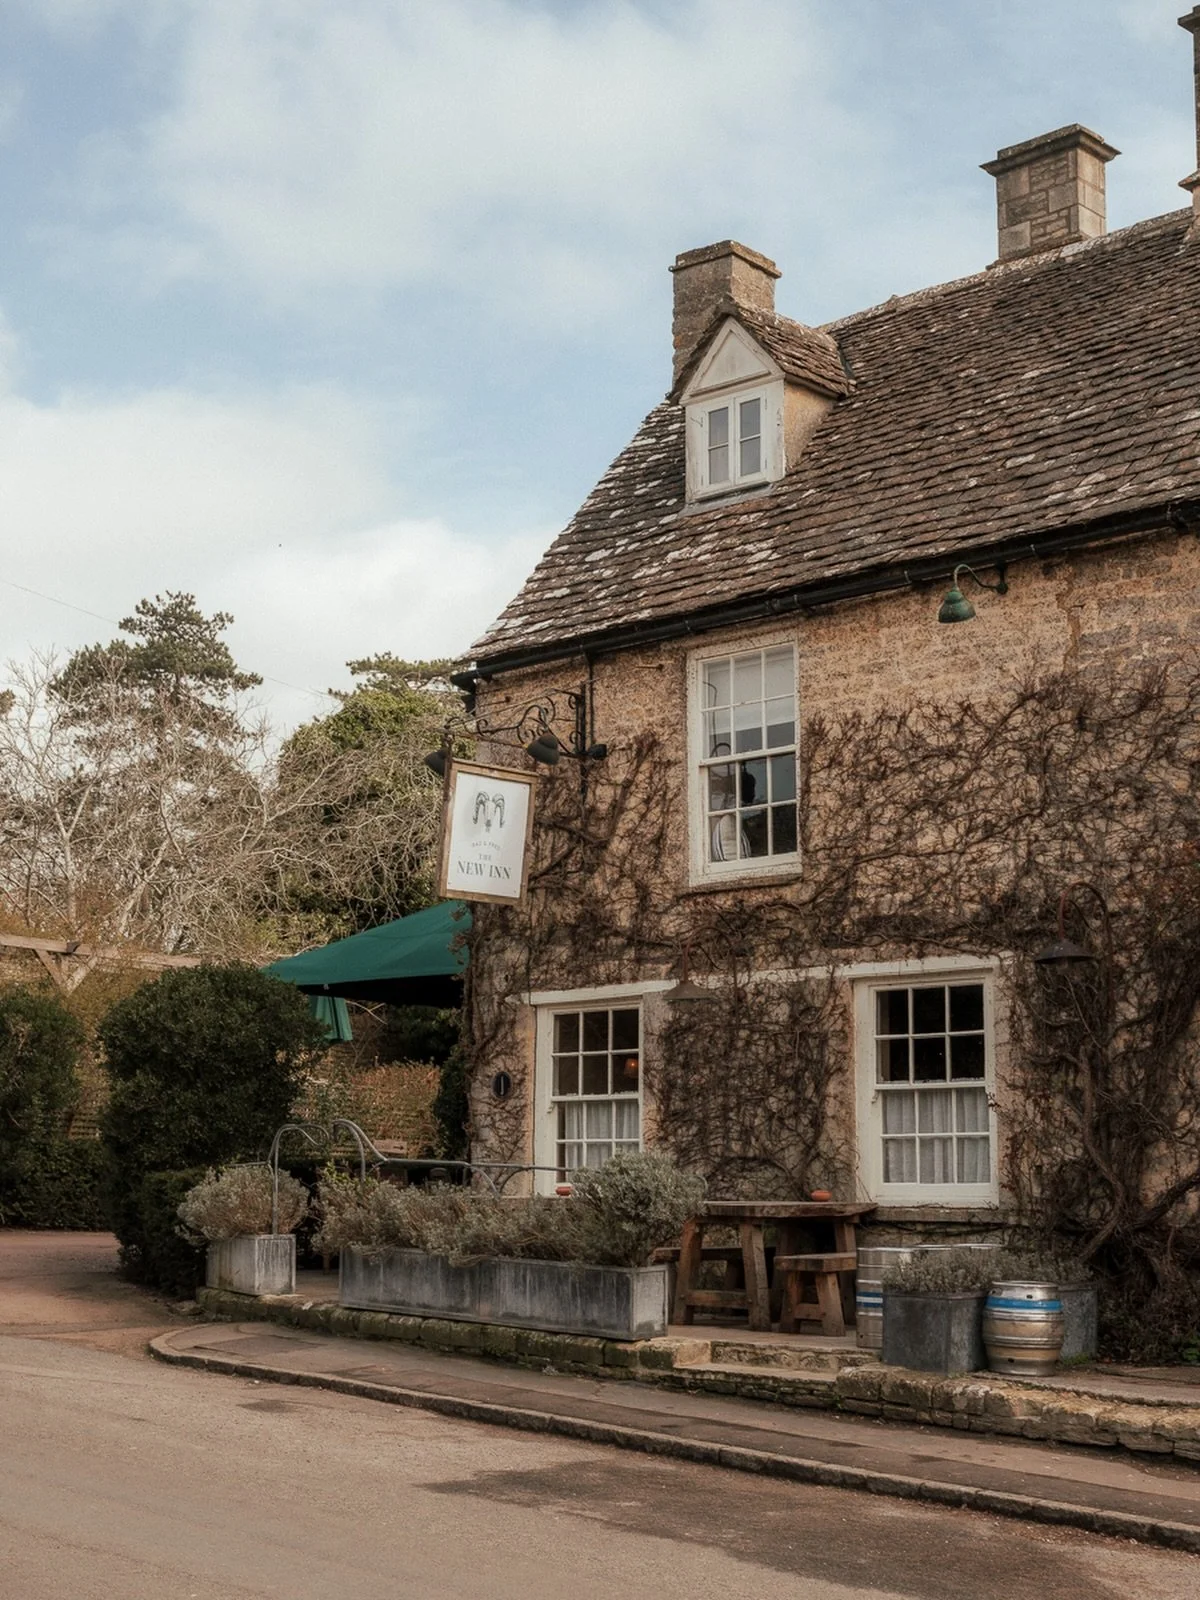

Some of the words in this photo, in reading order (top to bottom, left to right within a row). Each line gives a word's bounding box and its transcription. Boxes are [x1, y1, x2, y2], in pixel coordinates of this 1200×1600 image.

[479, 853, 492, 861] THE
[457, 860, 486, 877] NEW
[488, 864, 512, 880] INN
